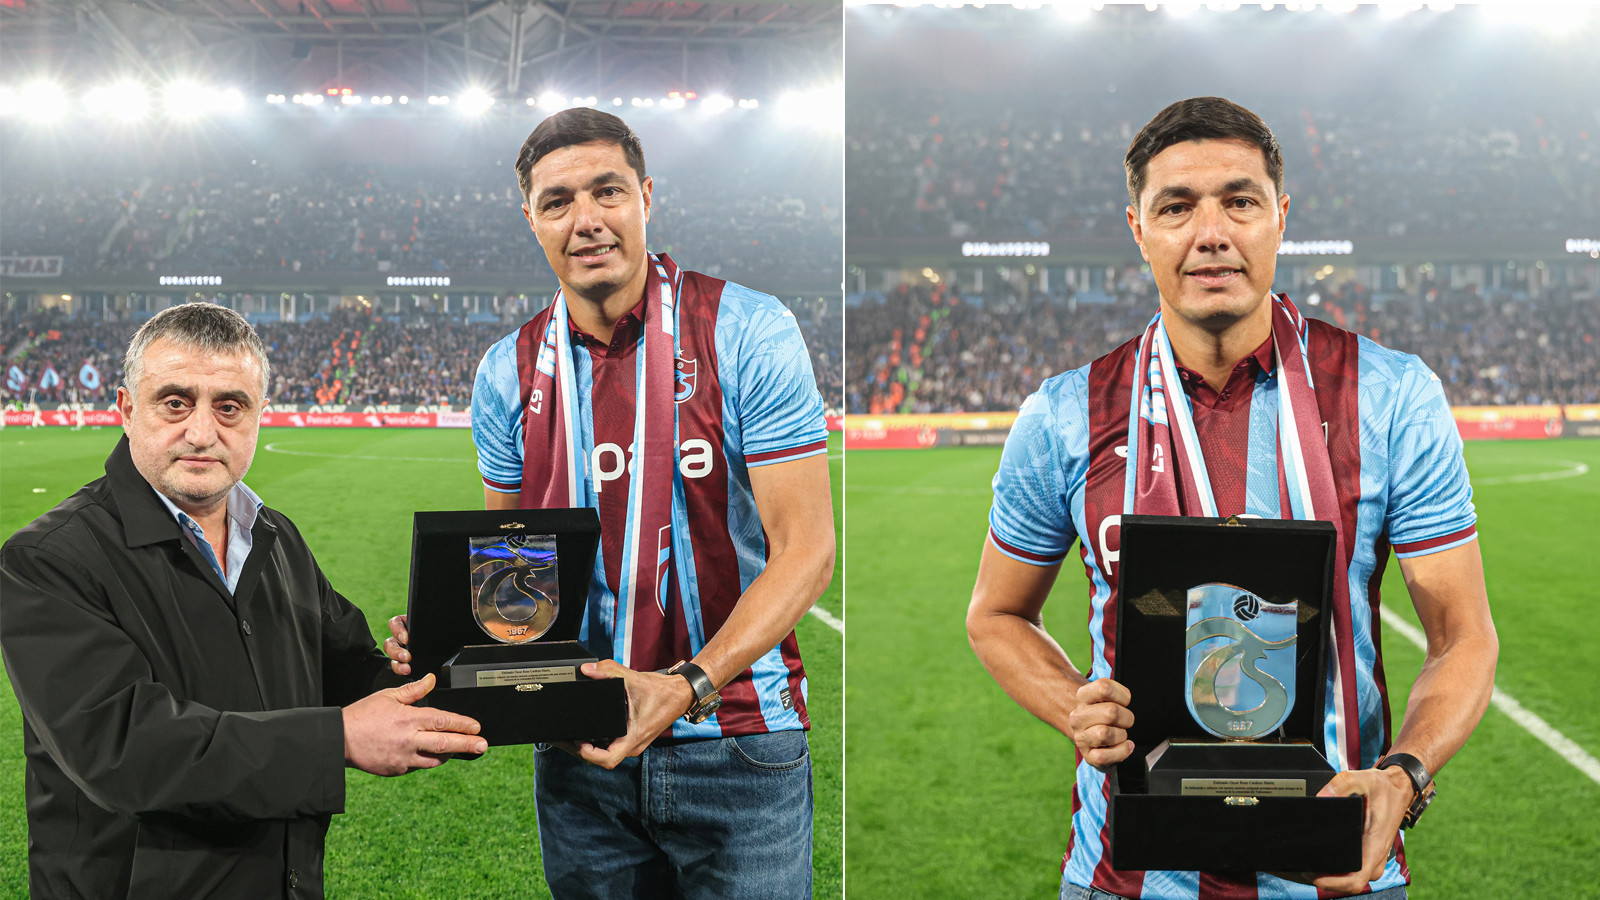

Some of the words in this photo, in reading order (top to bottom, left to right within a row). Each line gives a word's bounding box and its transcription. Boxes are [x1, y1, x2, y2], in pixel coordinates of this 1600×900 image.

[530, 389, 543, 415] 67
[508, 626, 528, 636] 1967
[1227, 720, 1253, 730] 1967
